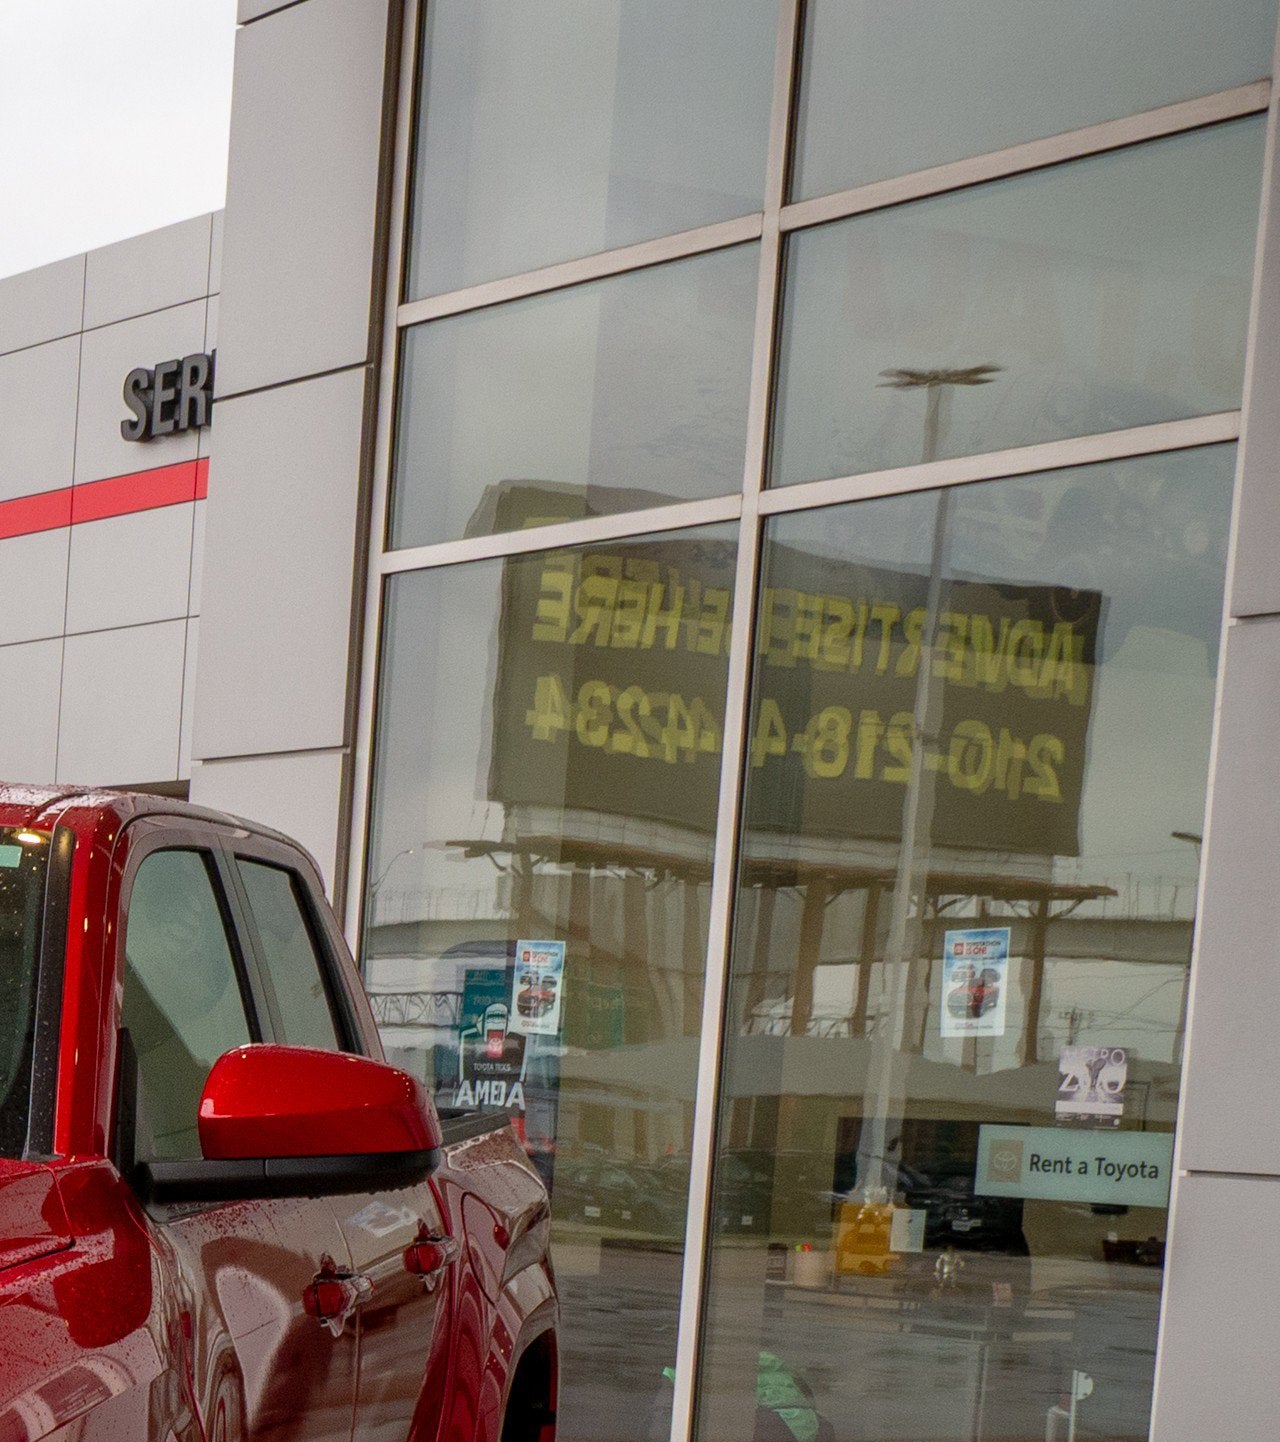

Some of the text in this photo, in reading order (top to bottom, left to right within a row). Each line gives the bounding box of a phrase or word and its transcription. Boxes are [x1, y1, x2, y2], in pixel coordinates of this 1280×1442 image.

[1029, 1153, 1159, 1182] Rent a Toyota
